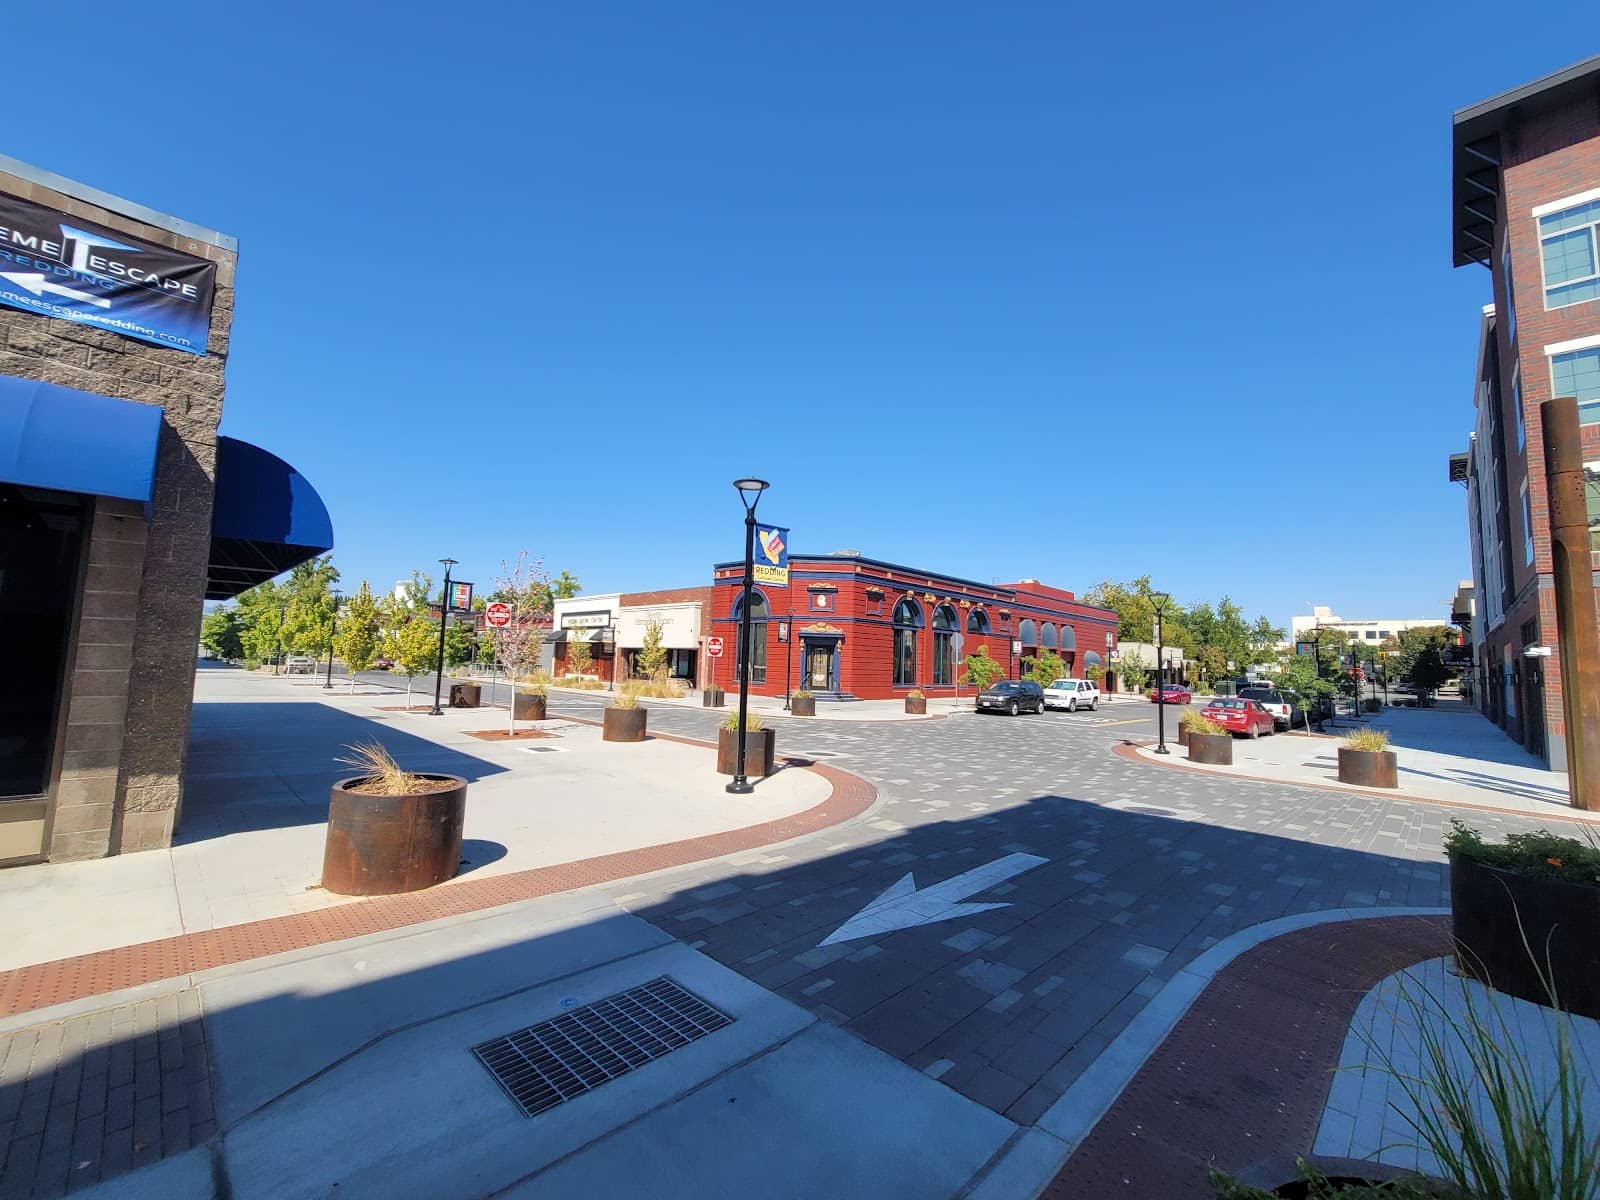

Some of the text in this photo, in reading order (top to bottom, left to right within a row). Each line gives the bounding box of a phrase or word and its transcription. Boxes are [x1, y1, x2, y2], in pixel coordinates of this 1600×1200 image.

[0, 249, 115, 290] REDDING
[89, 254, 198, 298] ESCAPE
[0, 290, 191, 346] meescaperedding.com
[755, 566, 786, 577] REDDING
